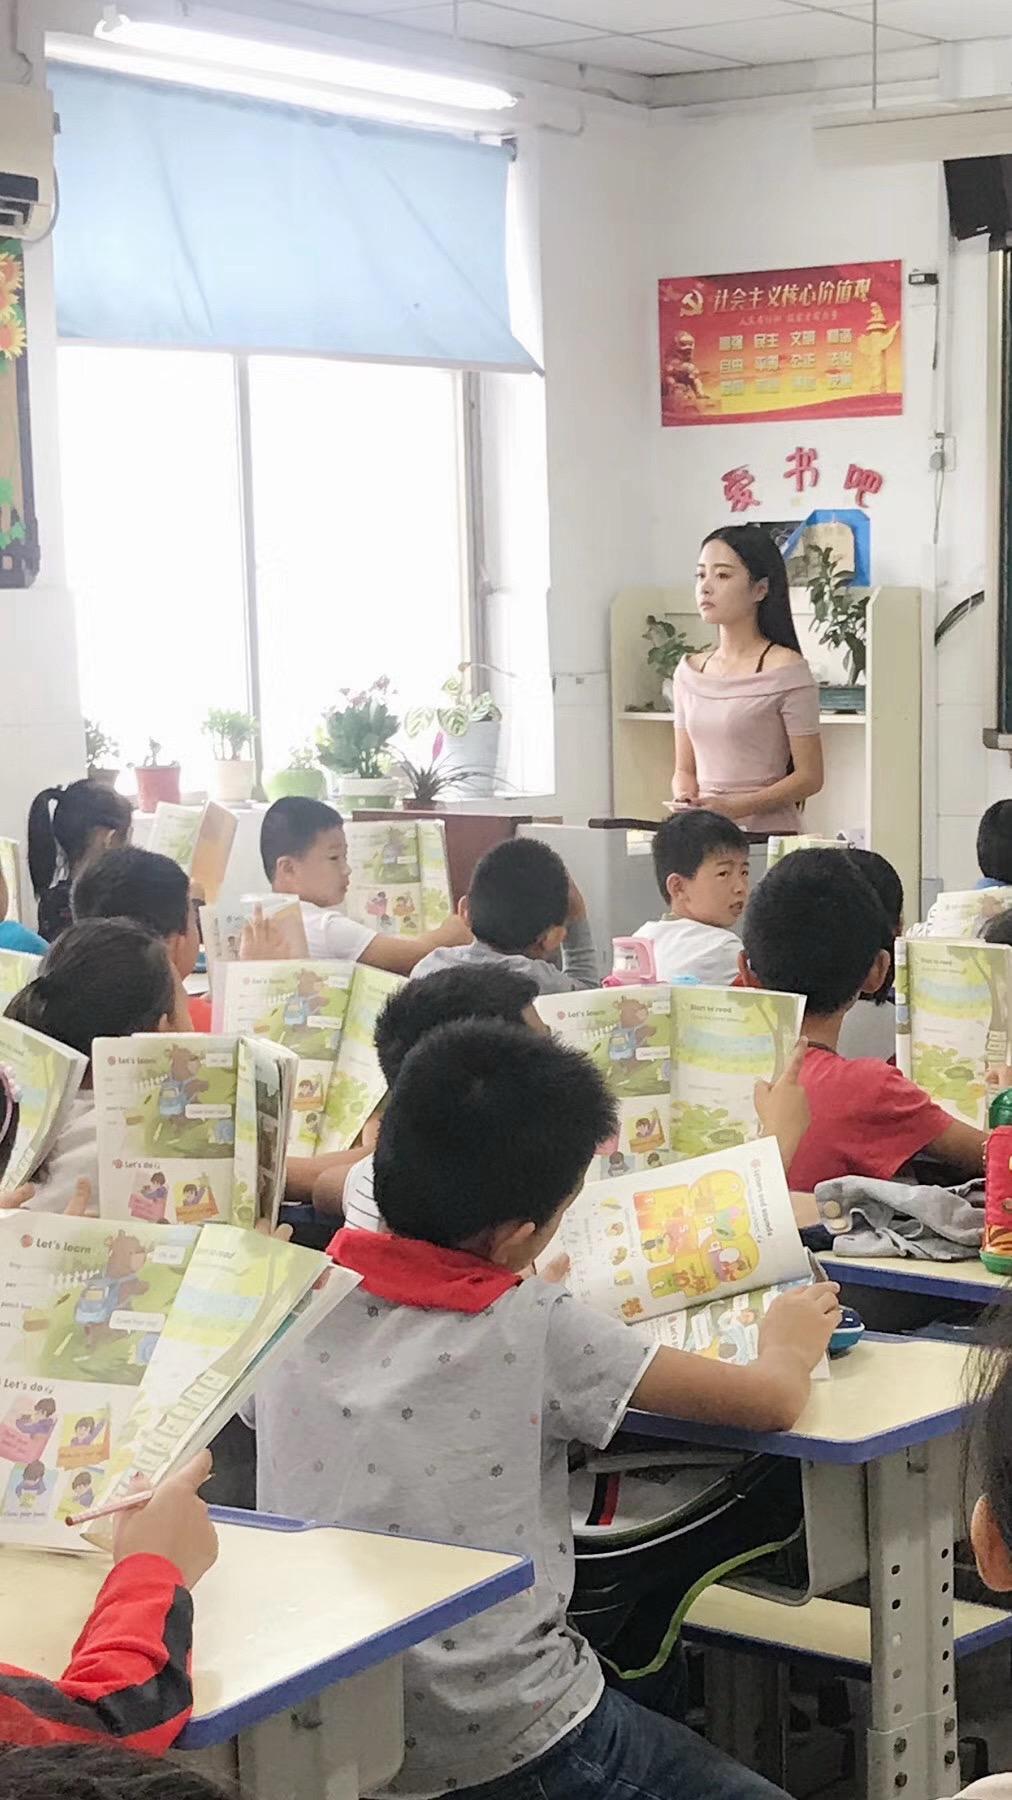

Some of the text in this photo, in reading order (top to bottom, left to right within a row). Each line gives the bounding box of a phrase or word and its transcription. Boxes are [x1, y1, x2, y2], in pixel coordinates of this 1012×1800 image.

[713, 278, 872, 313] 社会主义核心价值观
[36, 1237, 91, 1254] Let's learn
[4, 1378, 43, 1392] Let's do
